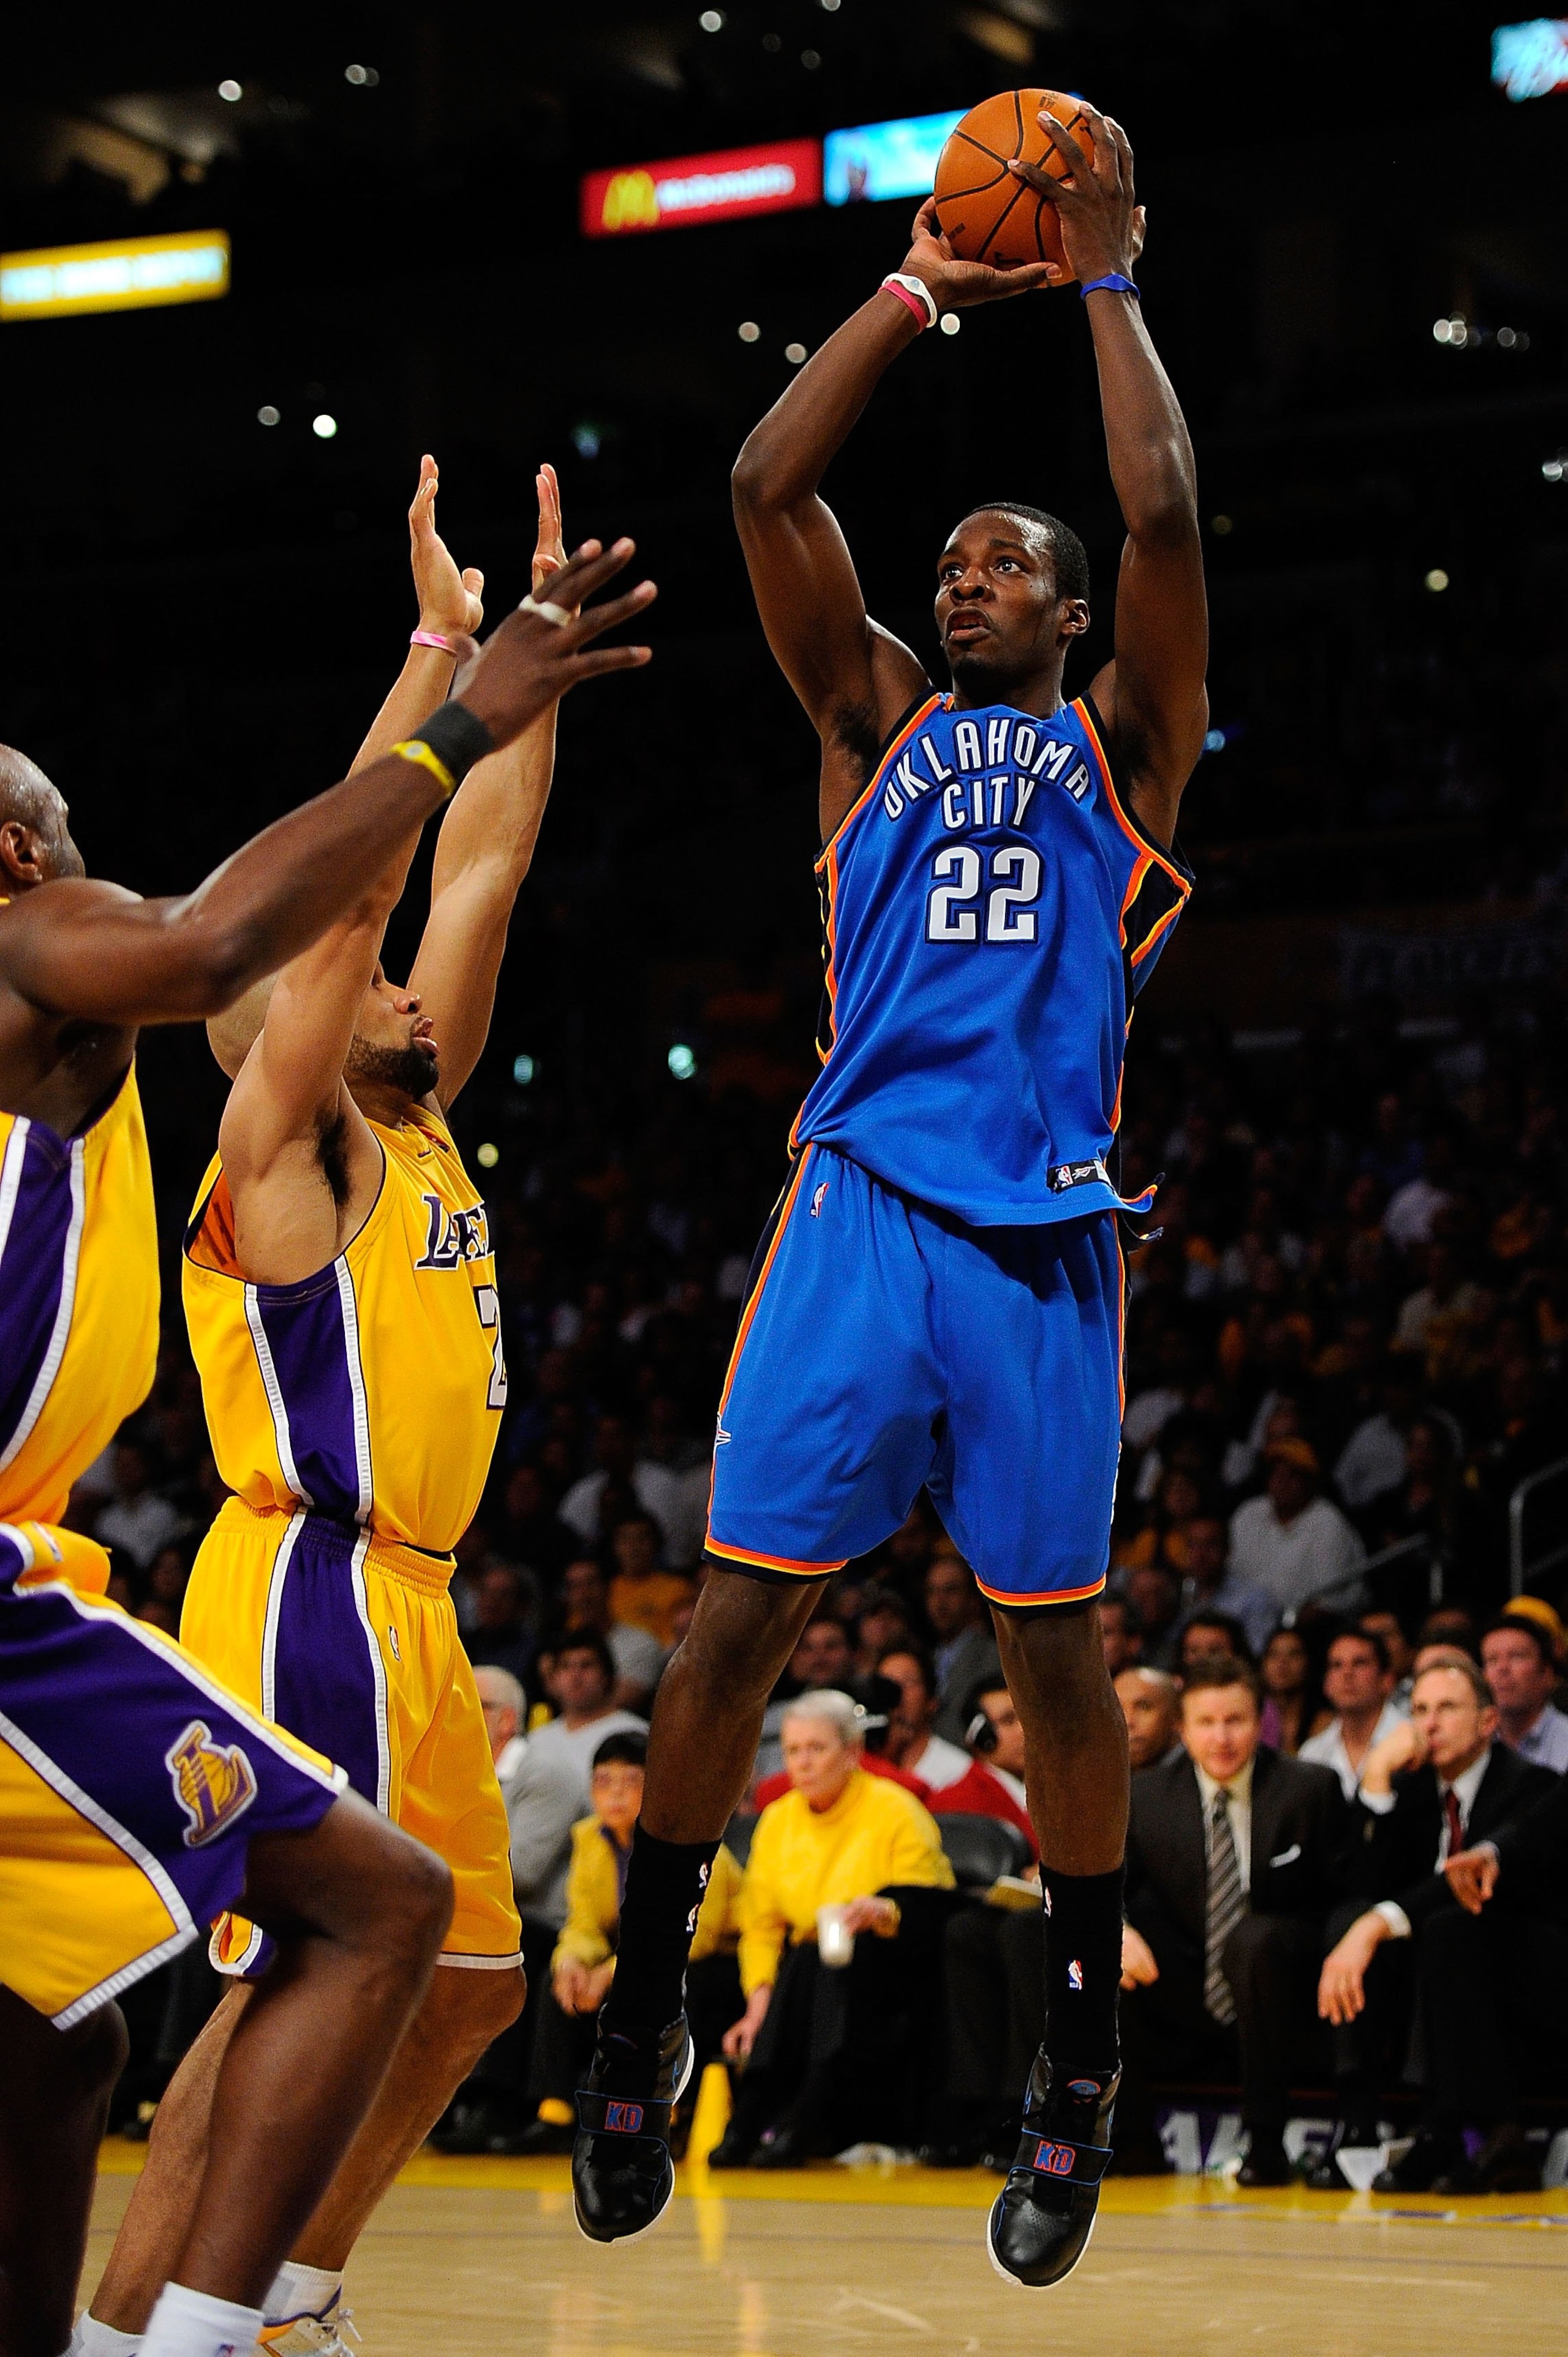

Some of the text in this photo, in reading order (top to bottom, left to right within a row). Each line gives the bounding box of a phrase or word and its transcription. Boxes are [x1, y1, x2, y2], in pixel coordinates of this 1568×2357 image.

[883, 718, 1090, 820] OKLAHOMA
[942, 774, 1036, 829] CITY
[927, 845, 1042, 943] 22
[604, 2101, 644, 2133] KD
[1033, 2140, 1076, 2176] KD
